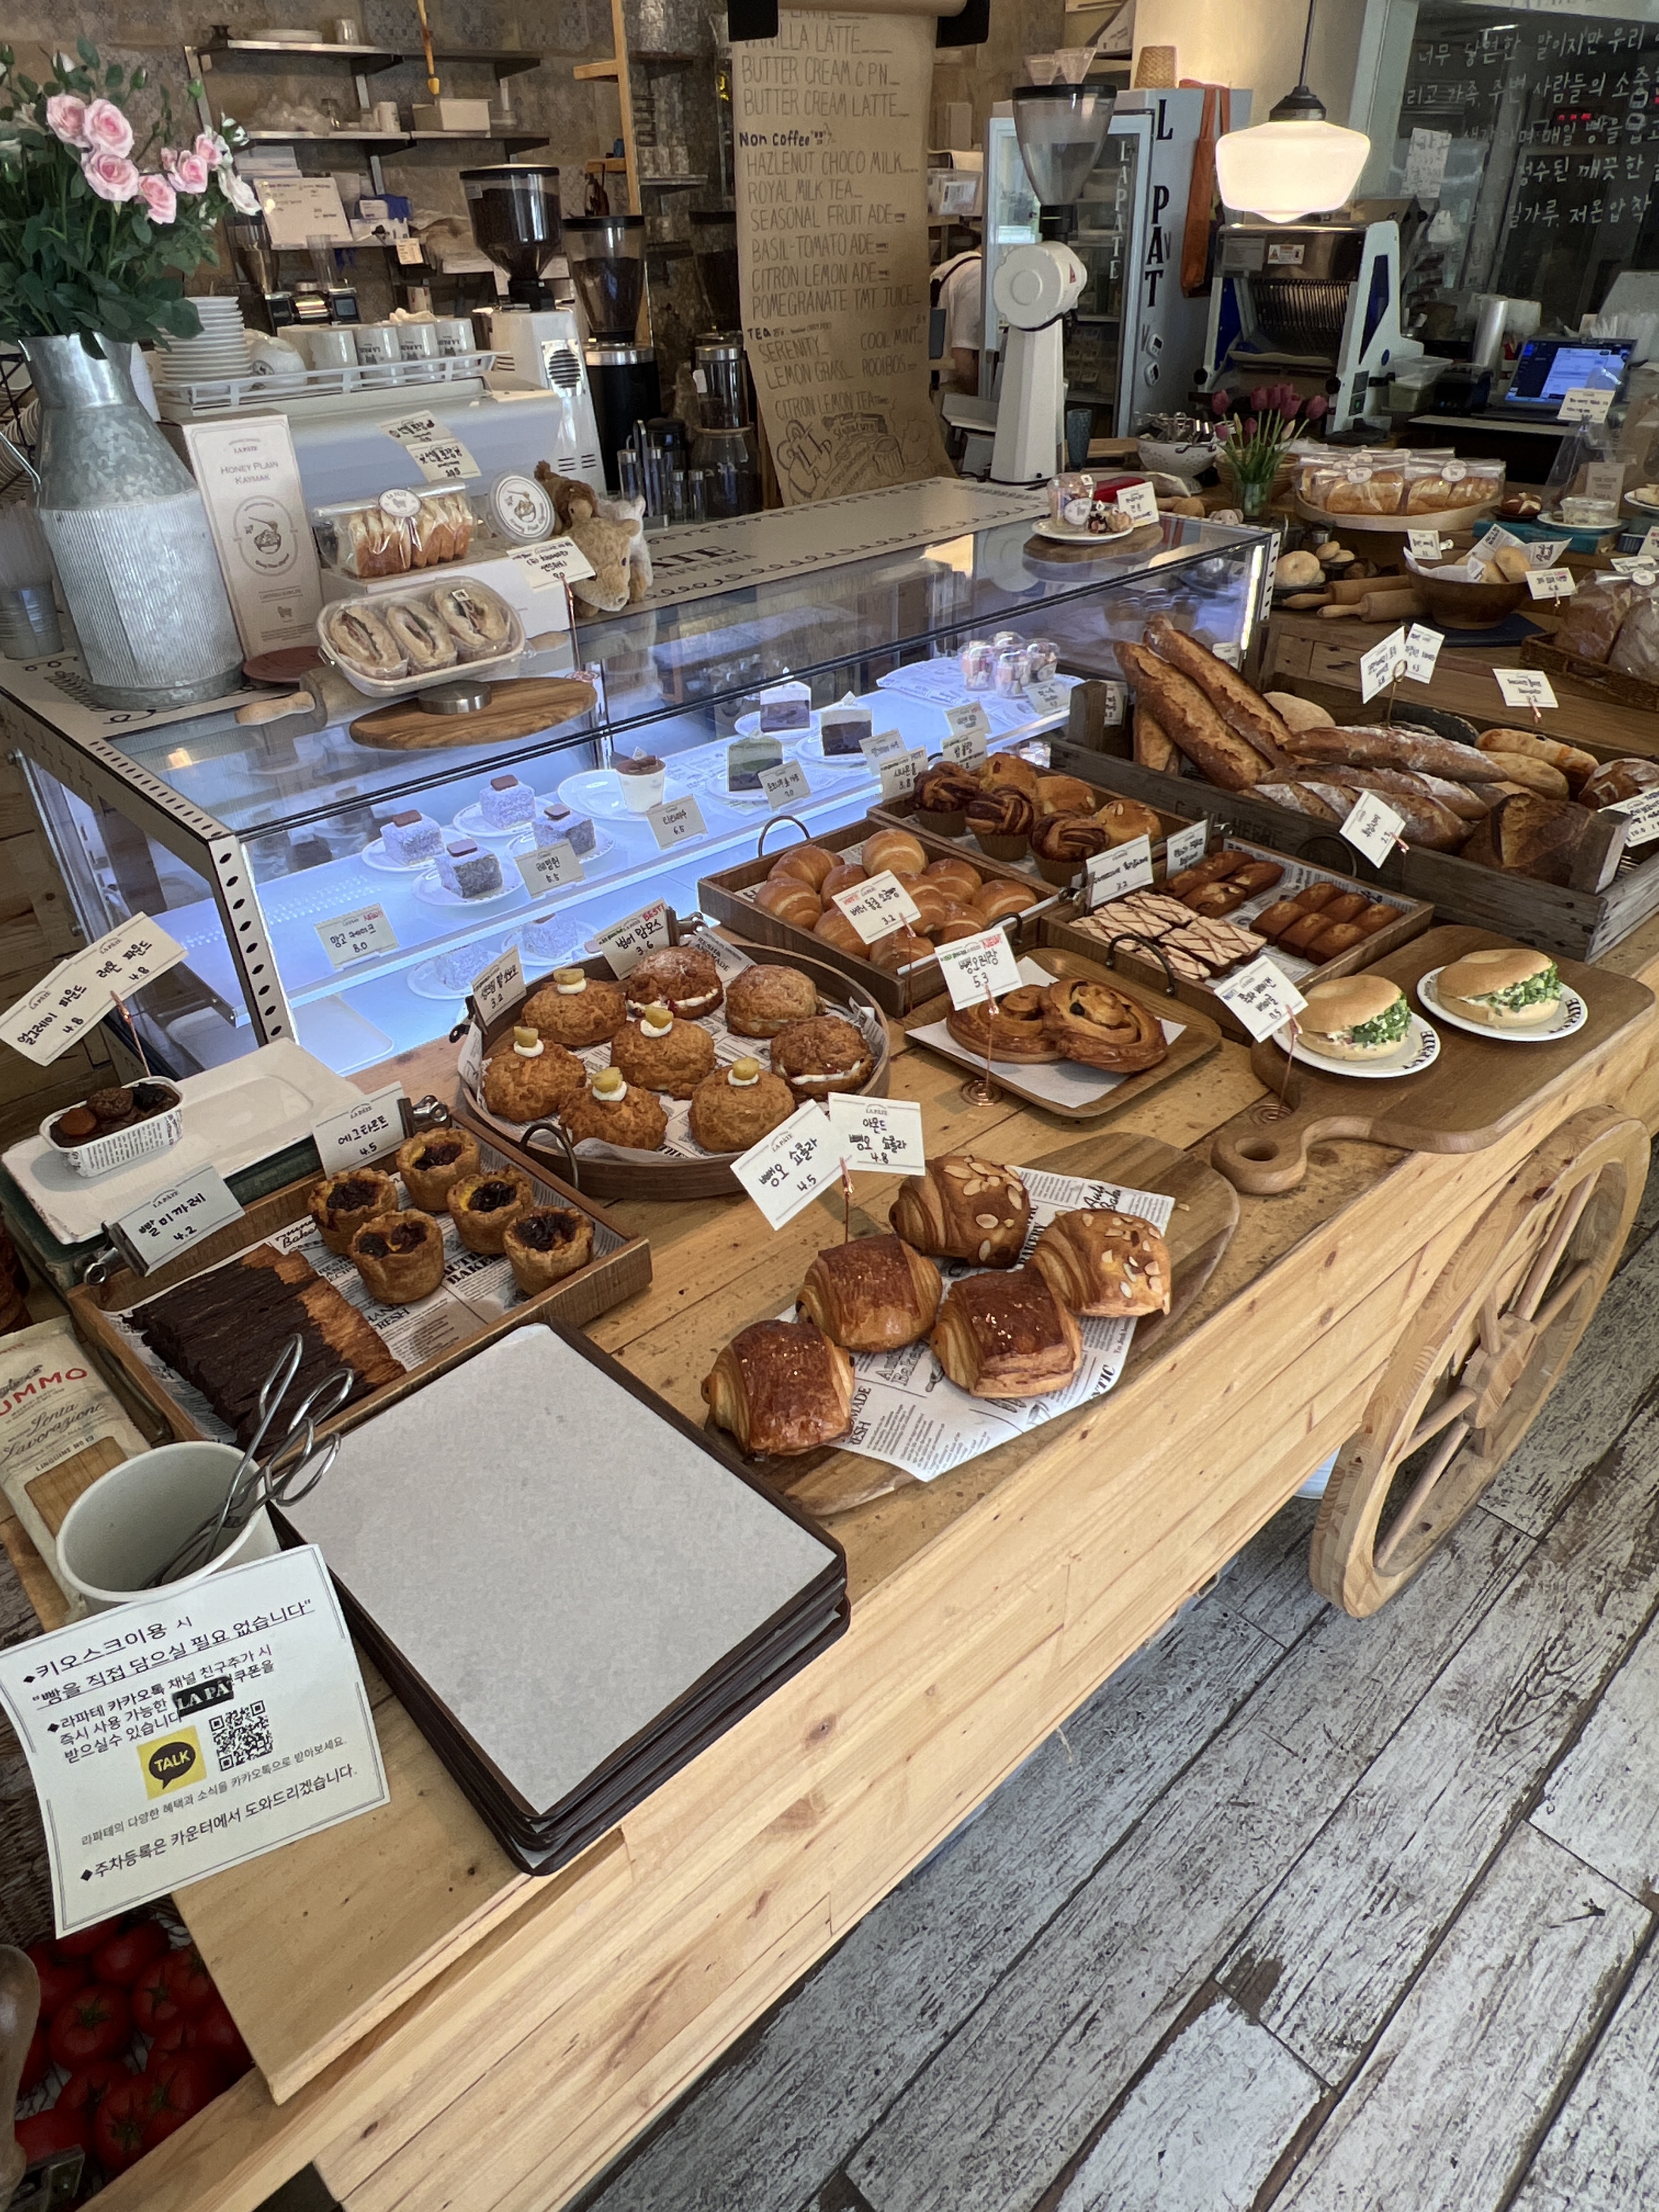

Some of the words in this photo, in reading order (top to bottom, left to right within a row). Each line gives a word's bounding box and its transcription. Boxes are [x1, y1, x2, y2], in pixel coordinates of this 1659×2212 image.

[815, 24, 861, 53] LATTE
[1419, 43, 1451, 67] 너무
[1537, 28, 1603, 61] 말이지만
[1608, 24, 1645, 53] 우리
[742, 55, 798, 84] BUTTER
[805, 57, 850, 86] CREAM
[1407, 84, 1438, 104] 리고
[1533, 71, 1606, 104] 사람들의
[744, 88, 798, 116] BUTTER
[804, 90, 847, 116] CREAM
[852, 92, 897, 117] LATTE
[740, 132, 767, 147] Non
[747, 151, 815, 177] HAZLENUT
[823, 150, 866, 176] CHOCO
[870, 151, 903, 174] MILK
[1577, 154, 1645, 182] 깨끗한
[747, 180, 792, 205] ROYAL
[795, 179, 823, 201] MILK
[829, 179, 854, 200] TEA
[751, 206, 821, 232] SEASONAL
[827, 205, 864, 227] FRUIT
[868, 204, 894, 224] ADE
[850, 233, 875, 255] ADE
[752, 266, 799, 292] CITRON
[805, 263, 847, 287] LEMON
[852, 262, 878, 284] ADE
[753, 289, 847, 320] POMEGRANATE
[883, 284, 915, 308] JUICE
[759, 335, 820, 364] SERENITY
[860, 331, 891, 352] COOL
[893, 326, 918, 346] MINT
[764, 363, 812, 390] LEMON
[815, 359, 849, 383] GRASS
[862, 356, 906, 378] ROOIBOS
[775, 394, 816, 421] CITRON
[817, 391, 854, 414] LEMON
[856, 391, 875, 410] TEA
[221, 464, 251, 475] HONEY
[253, 461, 279, 471] PLAIN
[235, 473, 270, 485] KAYMAK
[642, 902, 665, 922] BEST!
[881, 914, 896, 925] 3.2
[95, 961, 123, 978] 레몬
[122, 940, 153, 961] 파운드
[352, 941, 368, 953] 8.0
[128, 966, 150, 981] 4.8
[972, 972, 989, 988] 5.3
[17, 1012, 58, 1046] 얼그레이
[58, 984, 88, 1007] 파운드
[62, 1017, 84, 1034] 4.8
[337, 1115, 389, 1146] 에그타르트
[862, 1117, 888, 1135] 아몬드
[359, 1143, 377, 1156] 4.5
[789, 1137, 818, 1166] 쇼콜라
[870, 1152, 889, 1164] 4.8
[882, 1135, 908, 1153] 쇼콜라
[797, 1174, 817, 1191] 4.5
[173, 1225, 198, 1242] 4.2
[35, 1446, 72, 1472] LINGUINE
[85, 1434, 95, 1444] 13
[35, 1622, 168, 1679] 키오스크이용
[176, 1615, 193, 1633] 시
[86, 1666, 126, 1689] 직접
[130, 1642, 187, 1674] 담으실
[190, 1628, 230, 1654] 필요
[60, 1702, 106, 1729] 라파테
[107, 1683, 166, 1712] 카카오톡
[168, 1670, 198, 1691] 채널
[199, 1650, 255, 1678] 친구추가
[257, 1643, 273, 1658] 시
[59, 1725, 88, 1746] 즉시
[93, 1714, 122, 1735] 사용
[123, 1697, 168, 1724] 가능한
[230, 1660, 274, 1685] 쿠폰을
[176, 1693, 201, 1711] LA
[63, 1730, 123, 1765] 받으실수
[154, 1751, 191, 1772] TALK
[81, 1820, 125, 1847] 라파테의
[127, 1807, 160, 1828] 다양한
[163, 1793, 195, 1814] 혜택과
[197, 1781, 228, 1802] 소식을
[230, 1758, 292, 1789] 카카오톡으로
[294, 1736, 348, 1763] 받아보세요.
[94, 1836, 167, 1878] 주차등록은
[170, 1807, 242, 1847] 카운터에서
[244, 1763, 358, 1817] 도와드리겠습니다.
